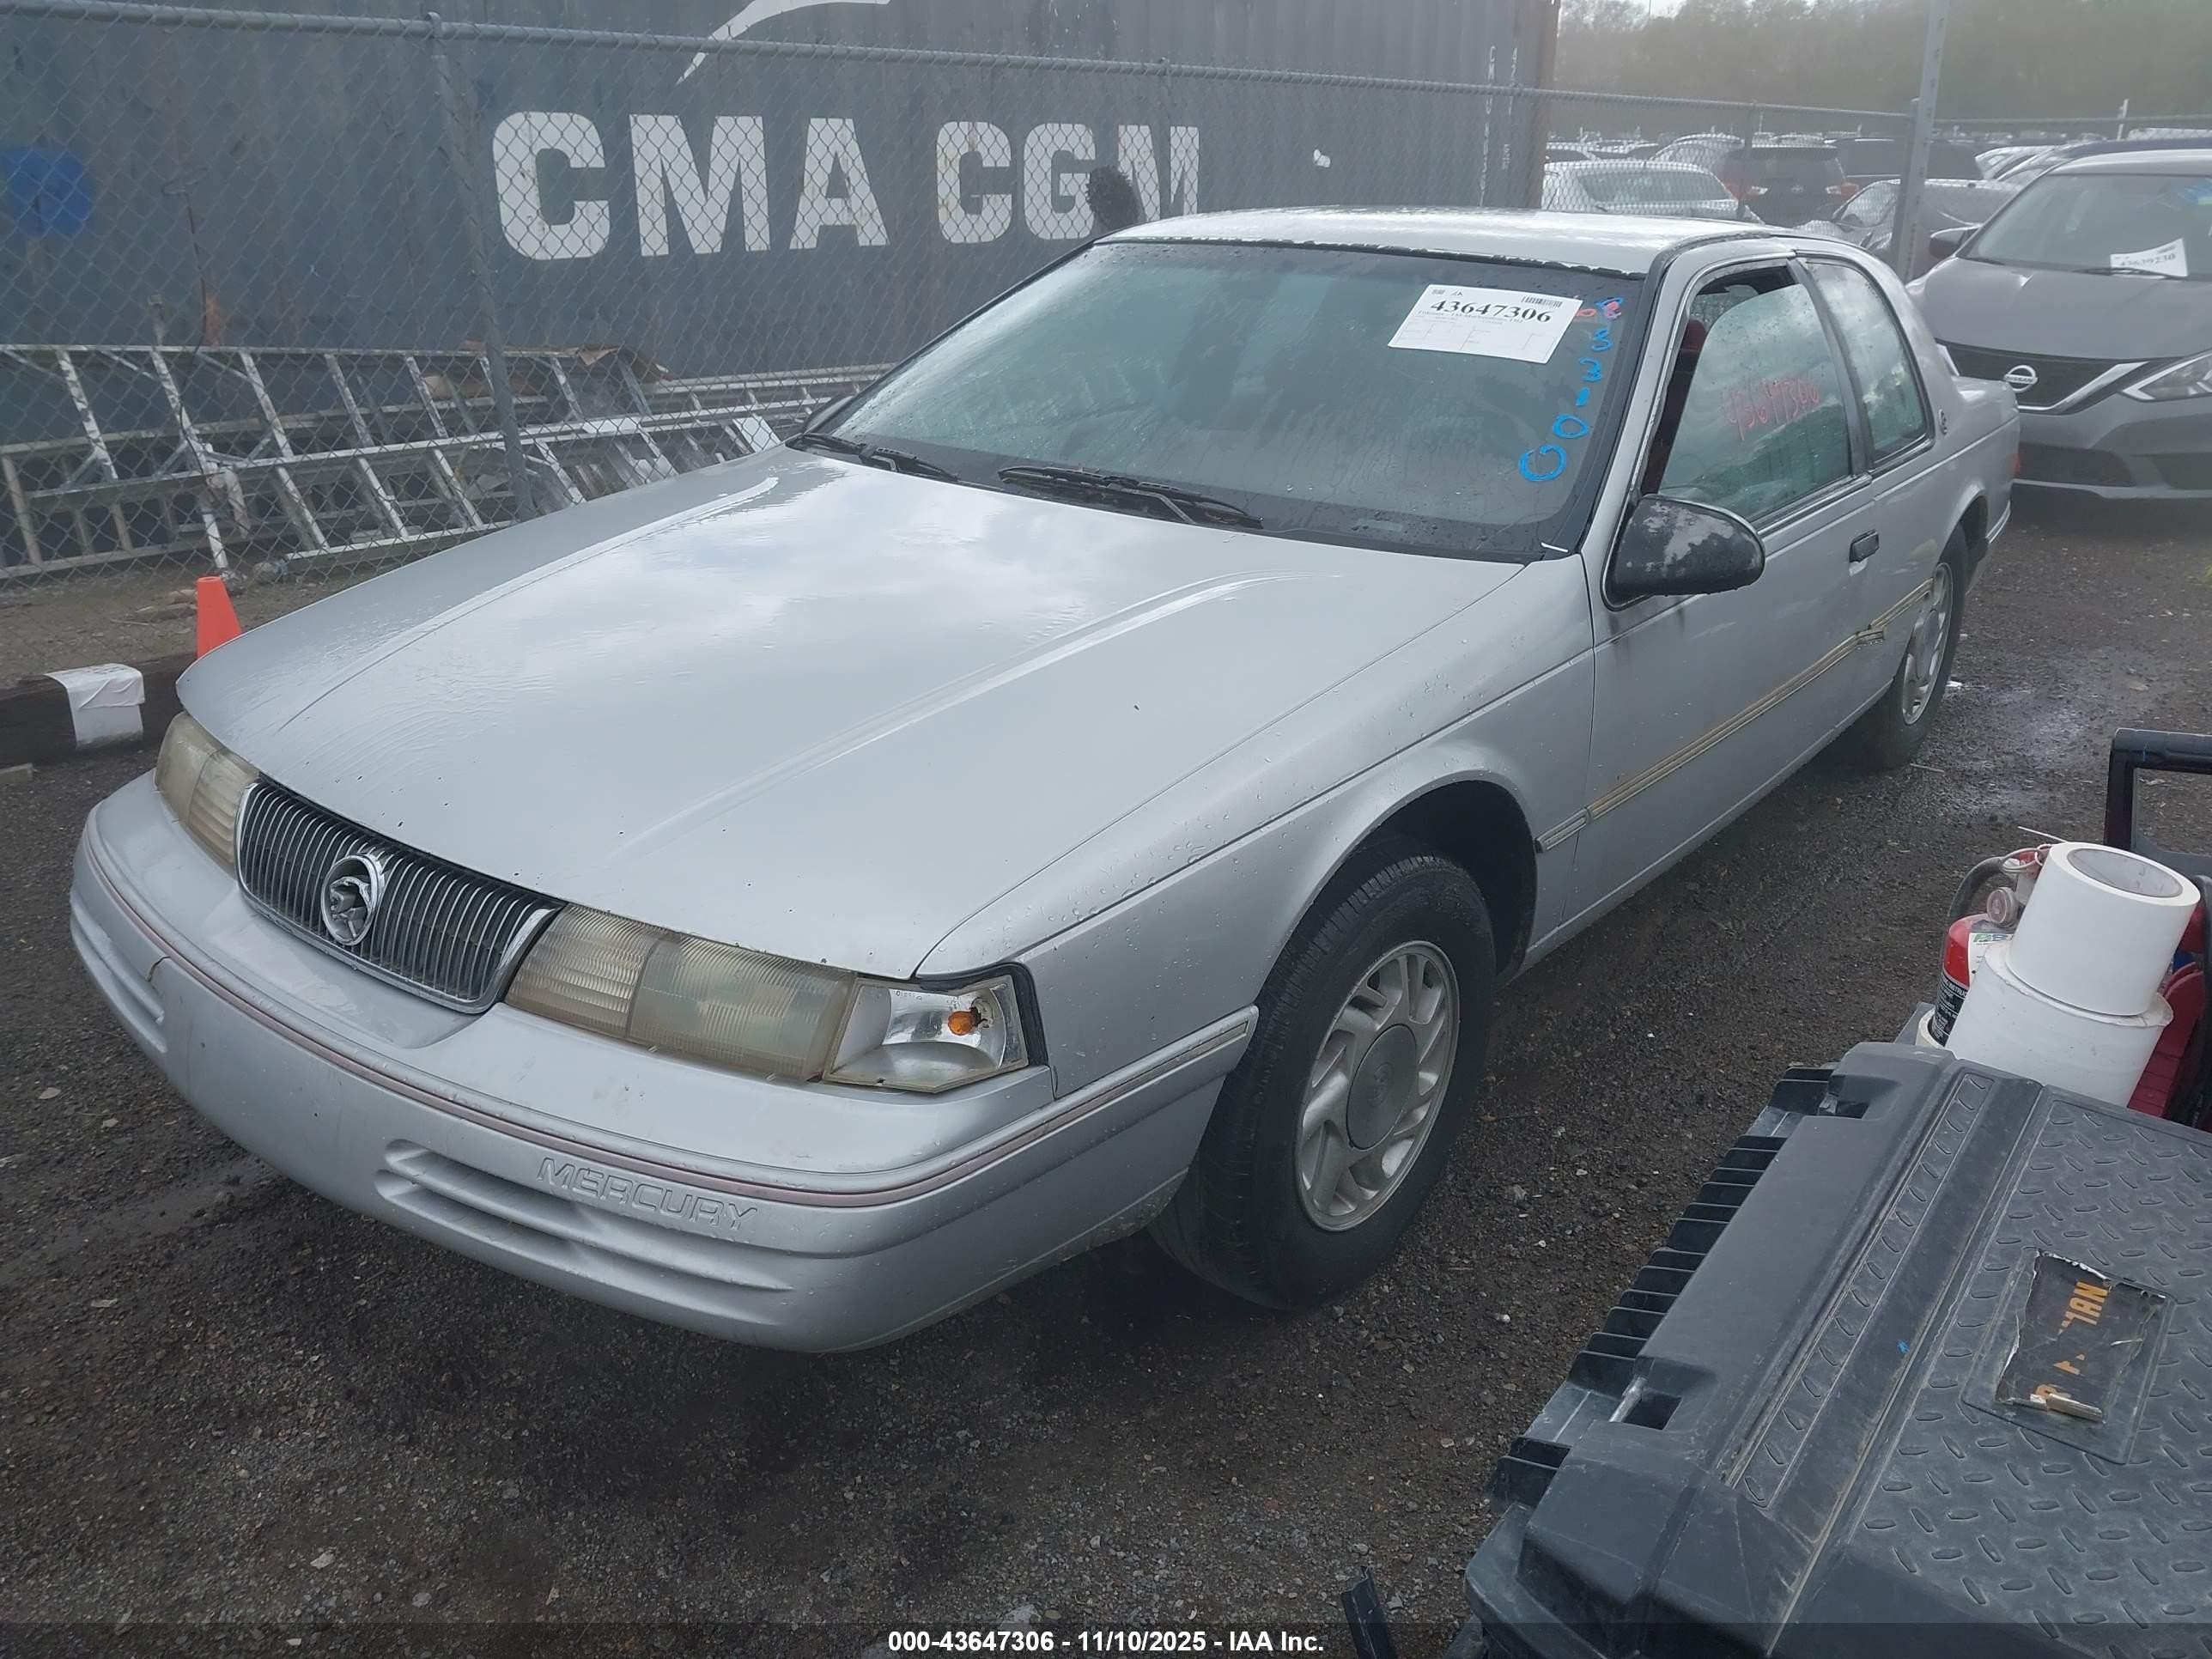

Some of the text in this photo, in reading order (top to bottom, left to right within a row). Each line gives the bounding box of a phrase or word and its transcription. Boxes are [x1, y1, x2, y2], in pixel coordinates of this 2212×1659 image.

[492, 111, 1200, 260] CMA CGM
[1430, 300, 1553, 323] 43647306
[538, 1157, 757, 1230] MERCURY
